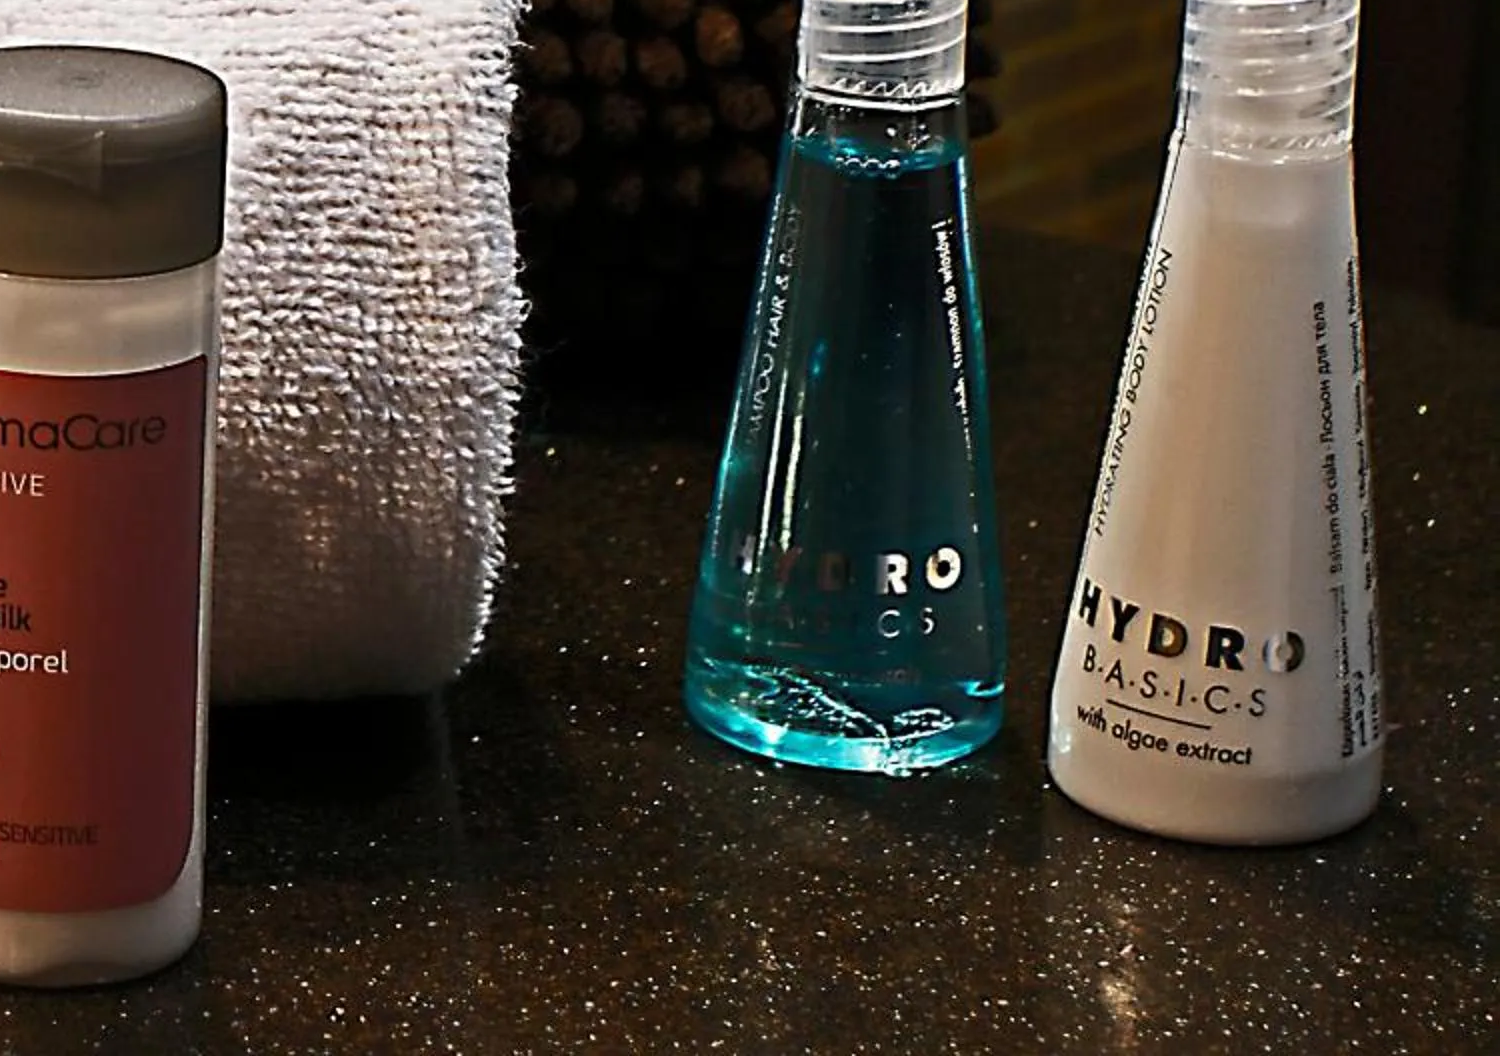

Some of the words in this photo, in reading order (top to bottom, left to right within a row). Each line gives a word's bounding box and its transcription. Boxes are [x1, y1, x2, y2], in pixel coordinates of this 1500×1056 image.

[767, 295, 787, 348] HAIR
[1126, 338, 1148, 403] BODY
[1142, 248, 1173, 335] LOTION
[1325, 493, 1339, 514] do
[1078, 578, 1305, 673] HYDRO
[1077, 705, 1107, 732] with
[1111, 718, 1169, 751] algae
[1176, 742, 1253, 765] extract
[0, 820, 100, 846] SENSITIVE
